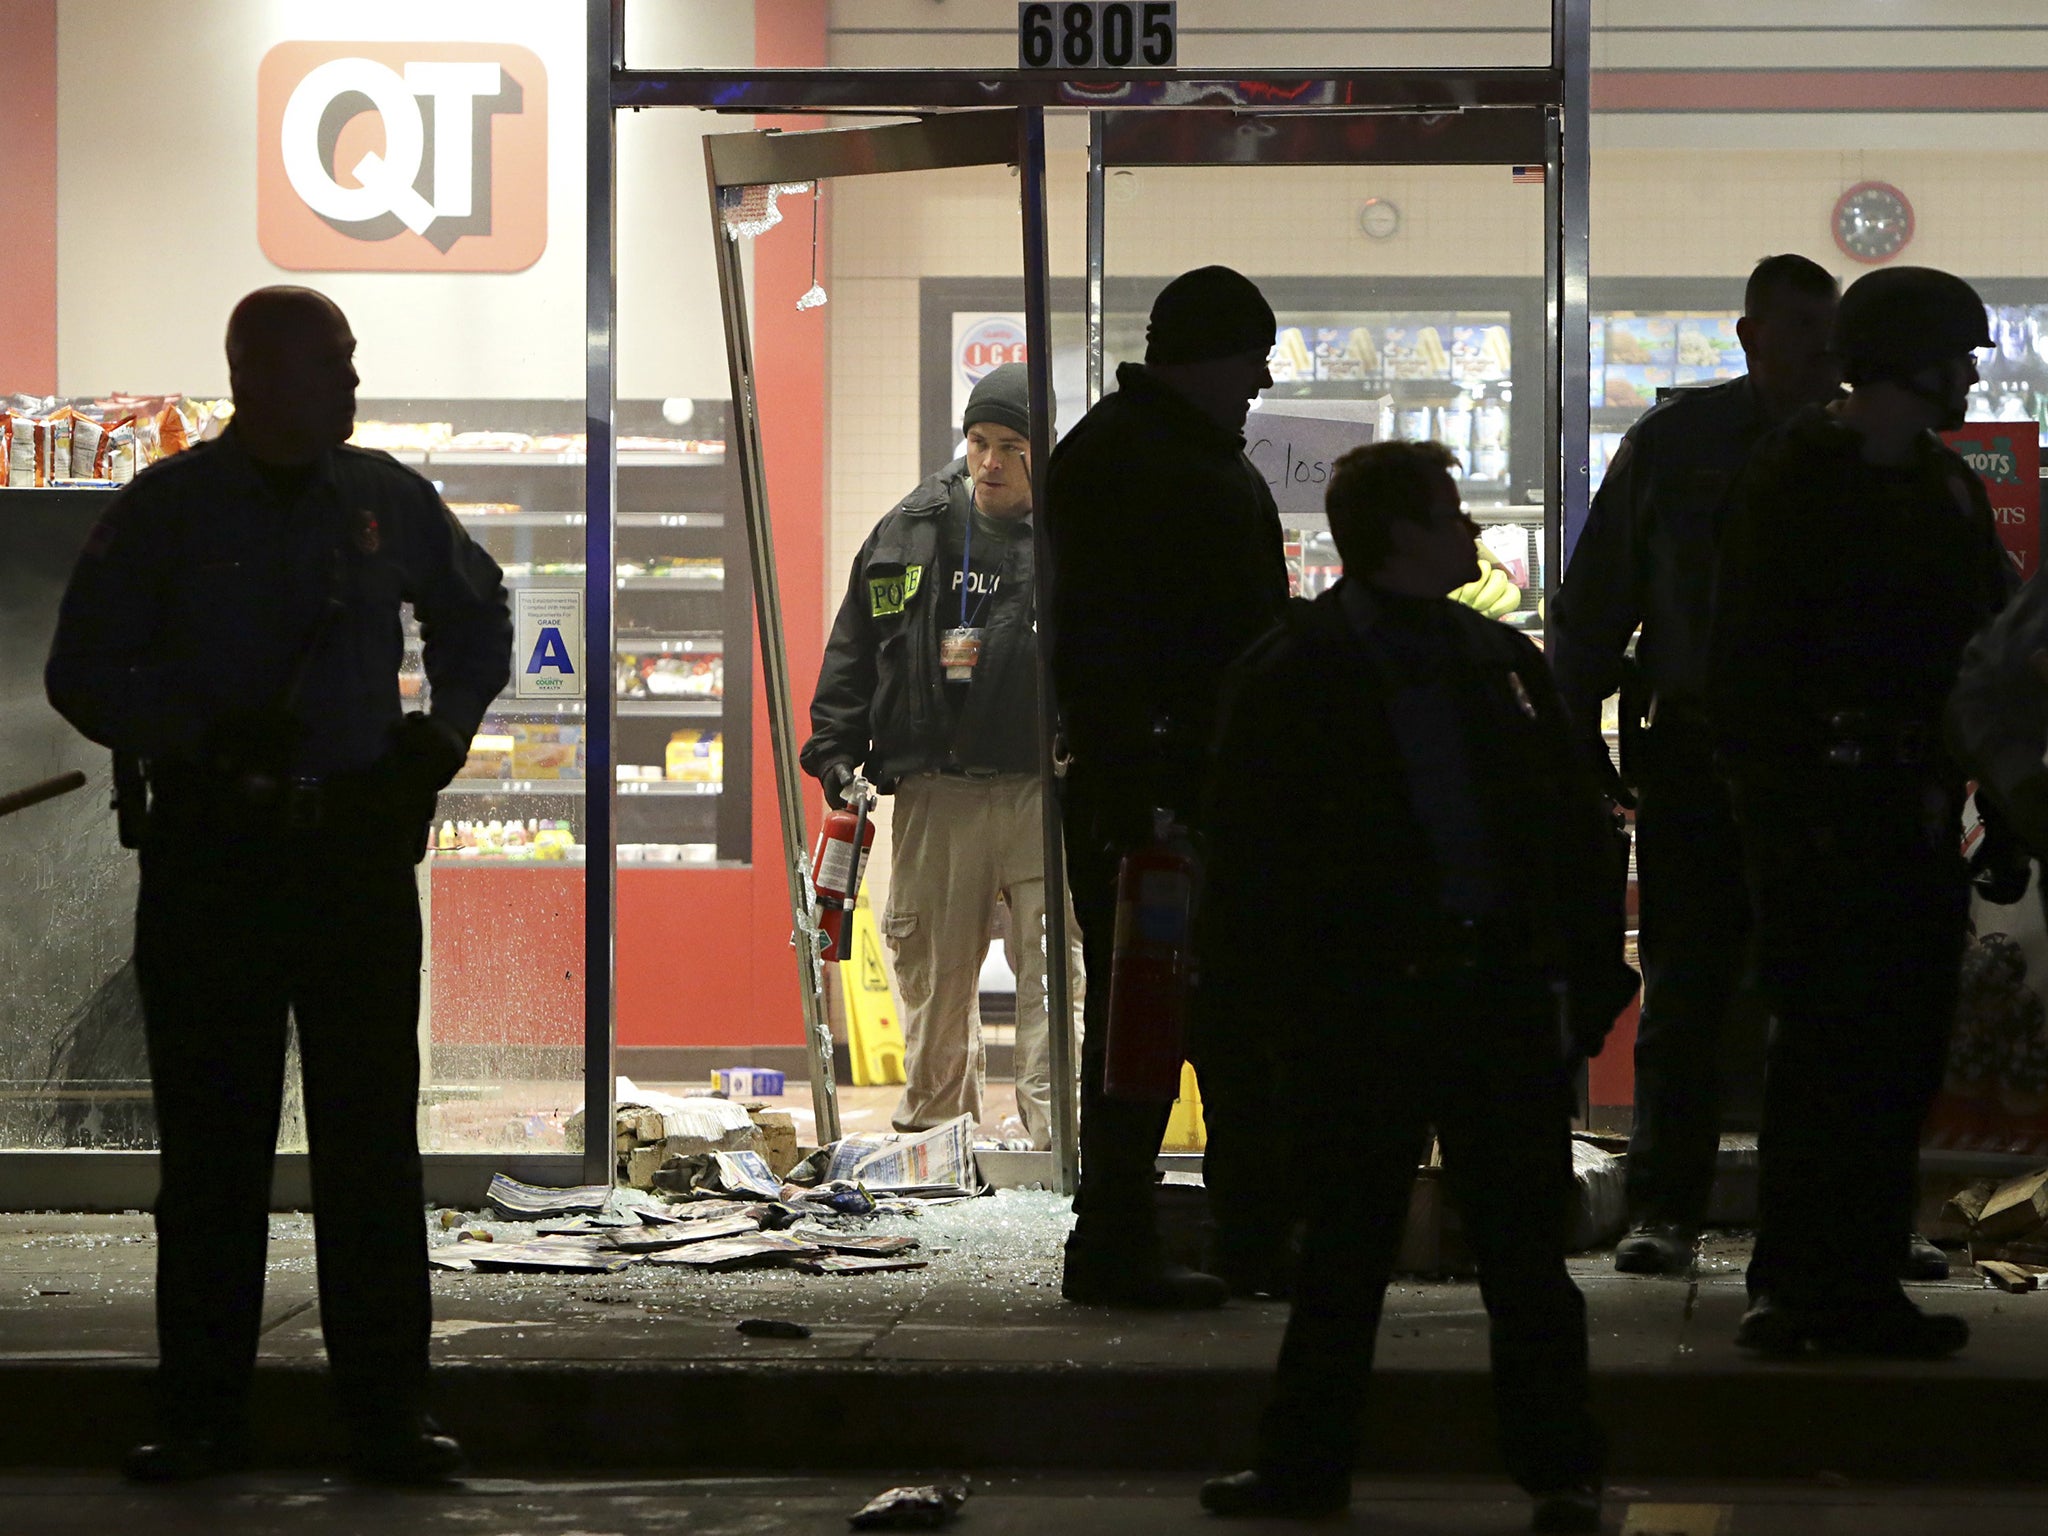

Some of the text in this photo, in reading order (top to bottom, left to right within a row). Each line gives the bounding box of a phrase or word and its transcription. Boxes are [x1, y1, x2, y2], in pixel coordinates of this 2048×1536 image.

[1022, 2, 1173, 67] 6805
[281, 56, 502, 237] QT
[1249, 439, 1336, 489] Clos
[1992, 506, 2026, 524] TS
[526, 627, 575, 674] A
